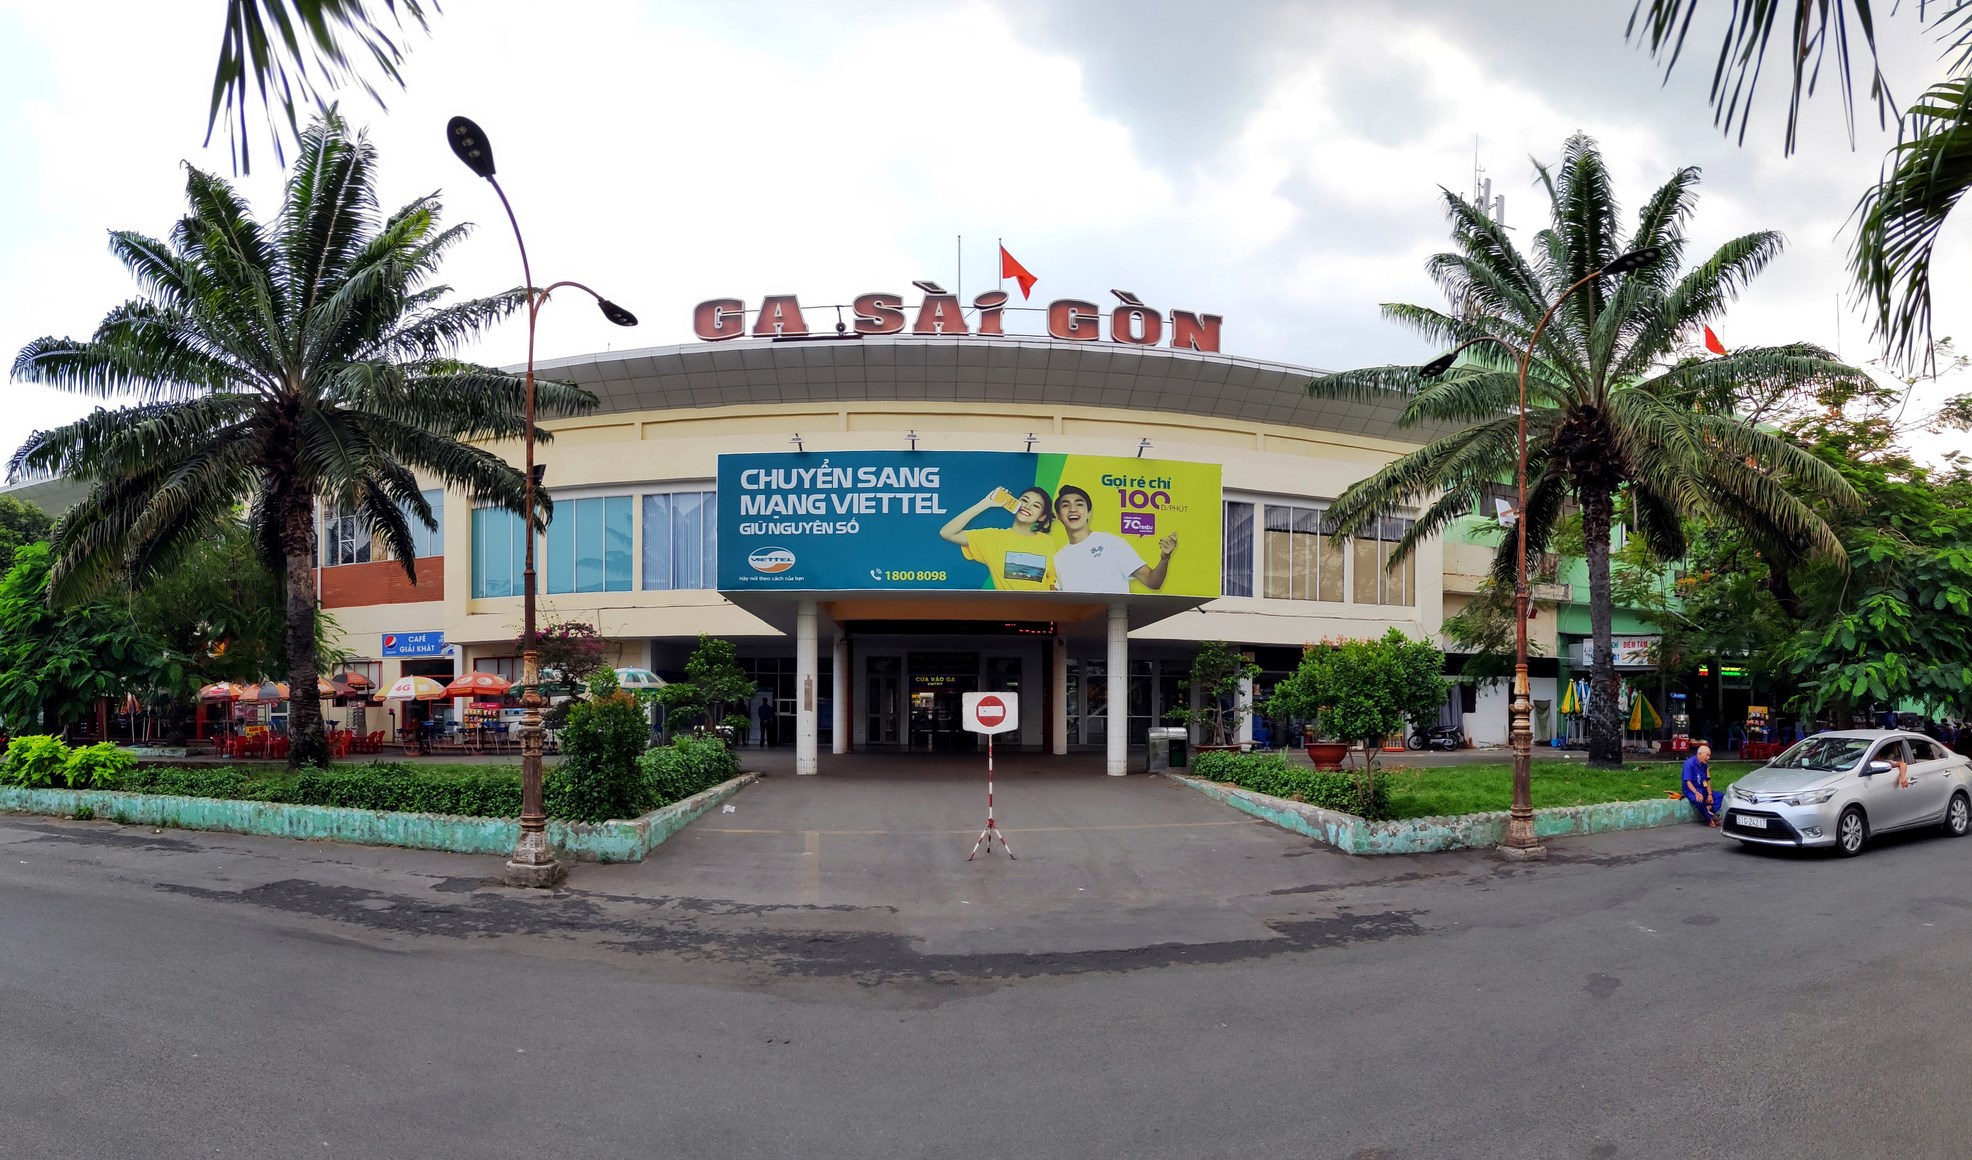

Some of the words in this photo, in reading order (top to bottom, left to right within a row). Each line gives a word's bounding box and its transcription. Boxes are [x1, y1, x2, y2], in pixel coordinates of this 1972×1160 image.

[693, 294, 809, 342] GA
[1046, 288, 1223, 353] GÒN
[740, 458, 853, 490] CHUYỂN
[857, 467, 940, 488] SANG
[1101, 474, 1127, 489] Gọi
[740, 494, 826, 518] MẠNG
[830, 493, 948, 514] VIETTEL
[1118, 489, 1171, 509] 100
[768, 520, 833, 535] NGUYÊN
[835, 517, 859, 534] SỐ
[885, 570, 914, 581] 1800
[916, 570, 947, 581] 8098
[408, 634, 426, 643] CAFÉ
